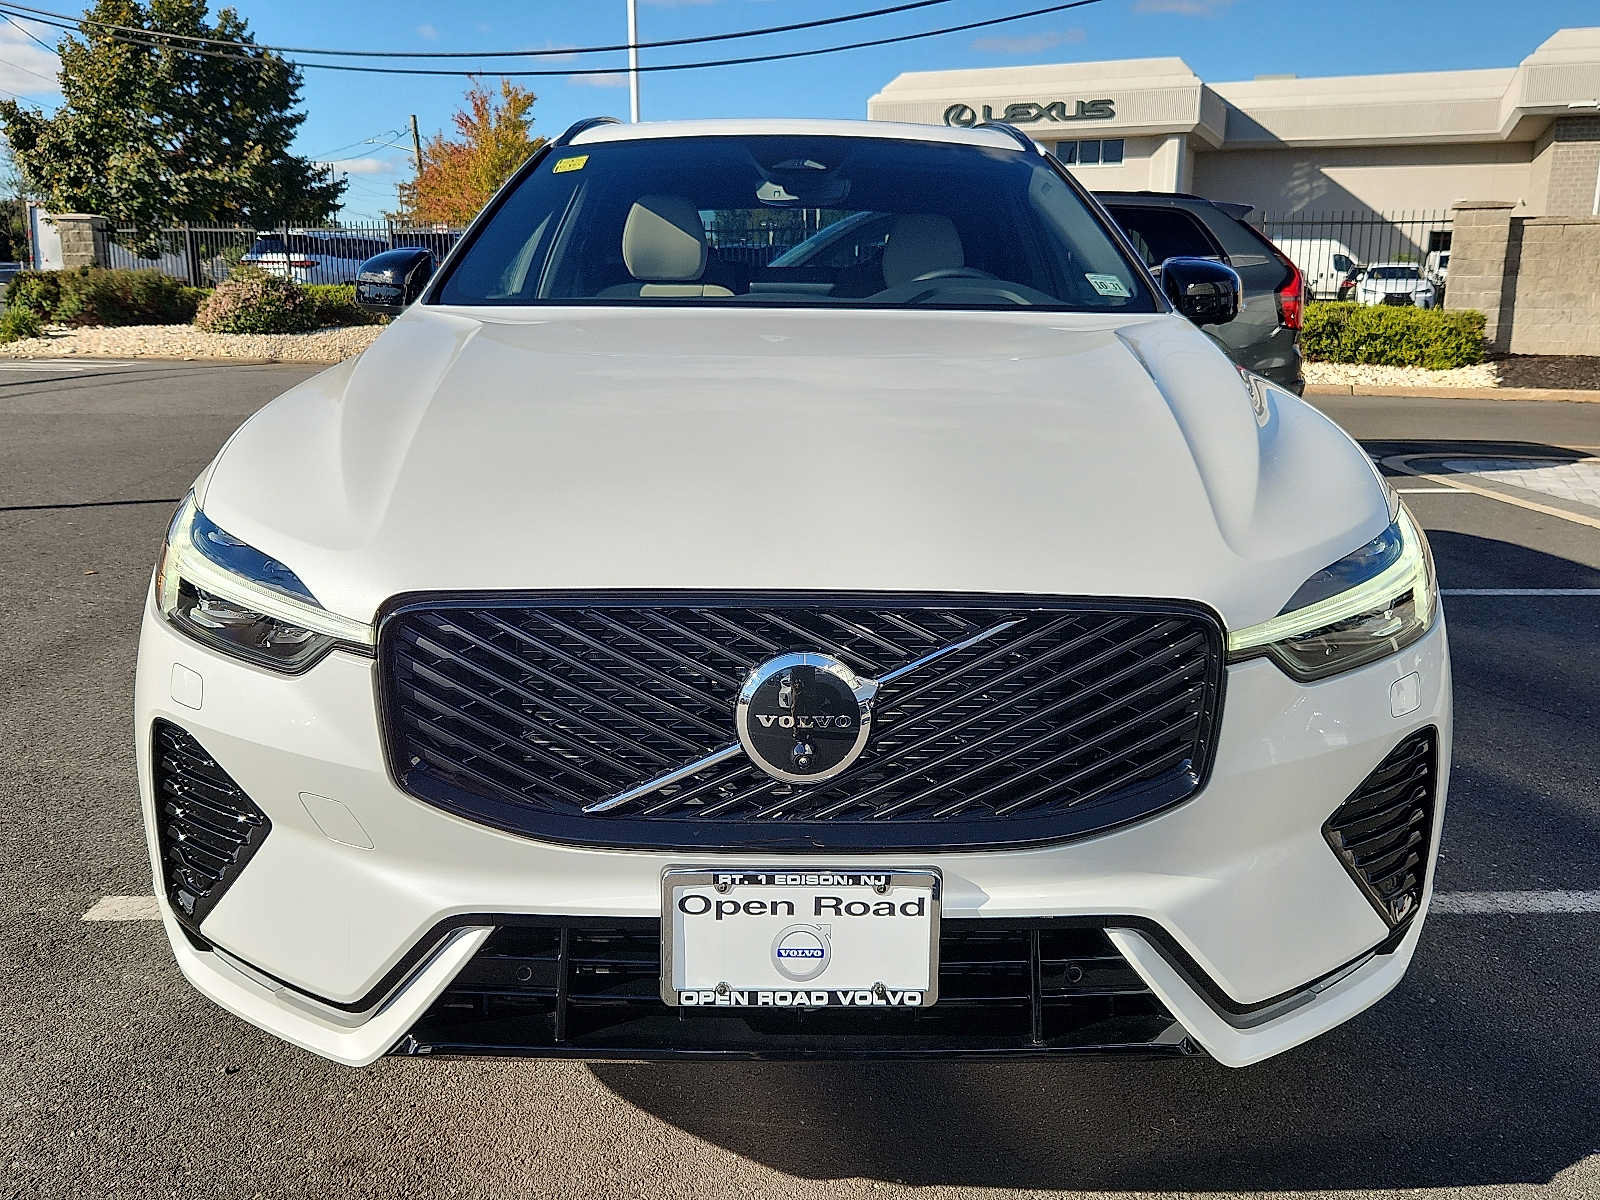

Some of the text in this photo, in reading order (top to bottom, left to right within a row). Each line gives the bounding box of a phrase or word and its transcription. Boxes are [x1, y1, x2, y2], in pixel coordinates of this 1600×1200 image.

[982, 99, 1116, 123] LEXUS
[755, 714, 851, 728] VOLVO
[718, 874, 886, 886] RT. 1 EDISON, NJ
[678, 894, 925, 920] Open Road
[780, 949, 822, 957] VOLVO
[680, 991, 922, 1006] OPEN ROAD VOLVO
